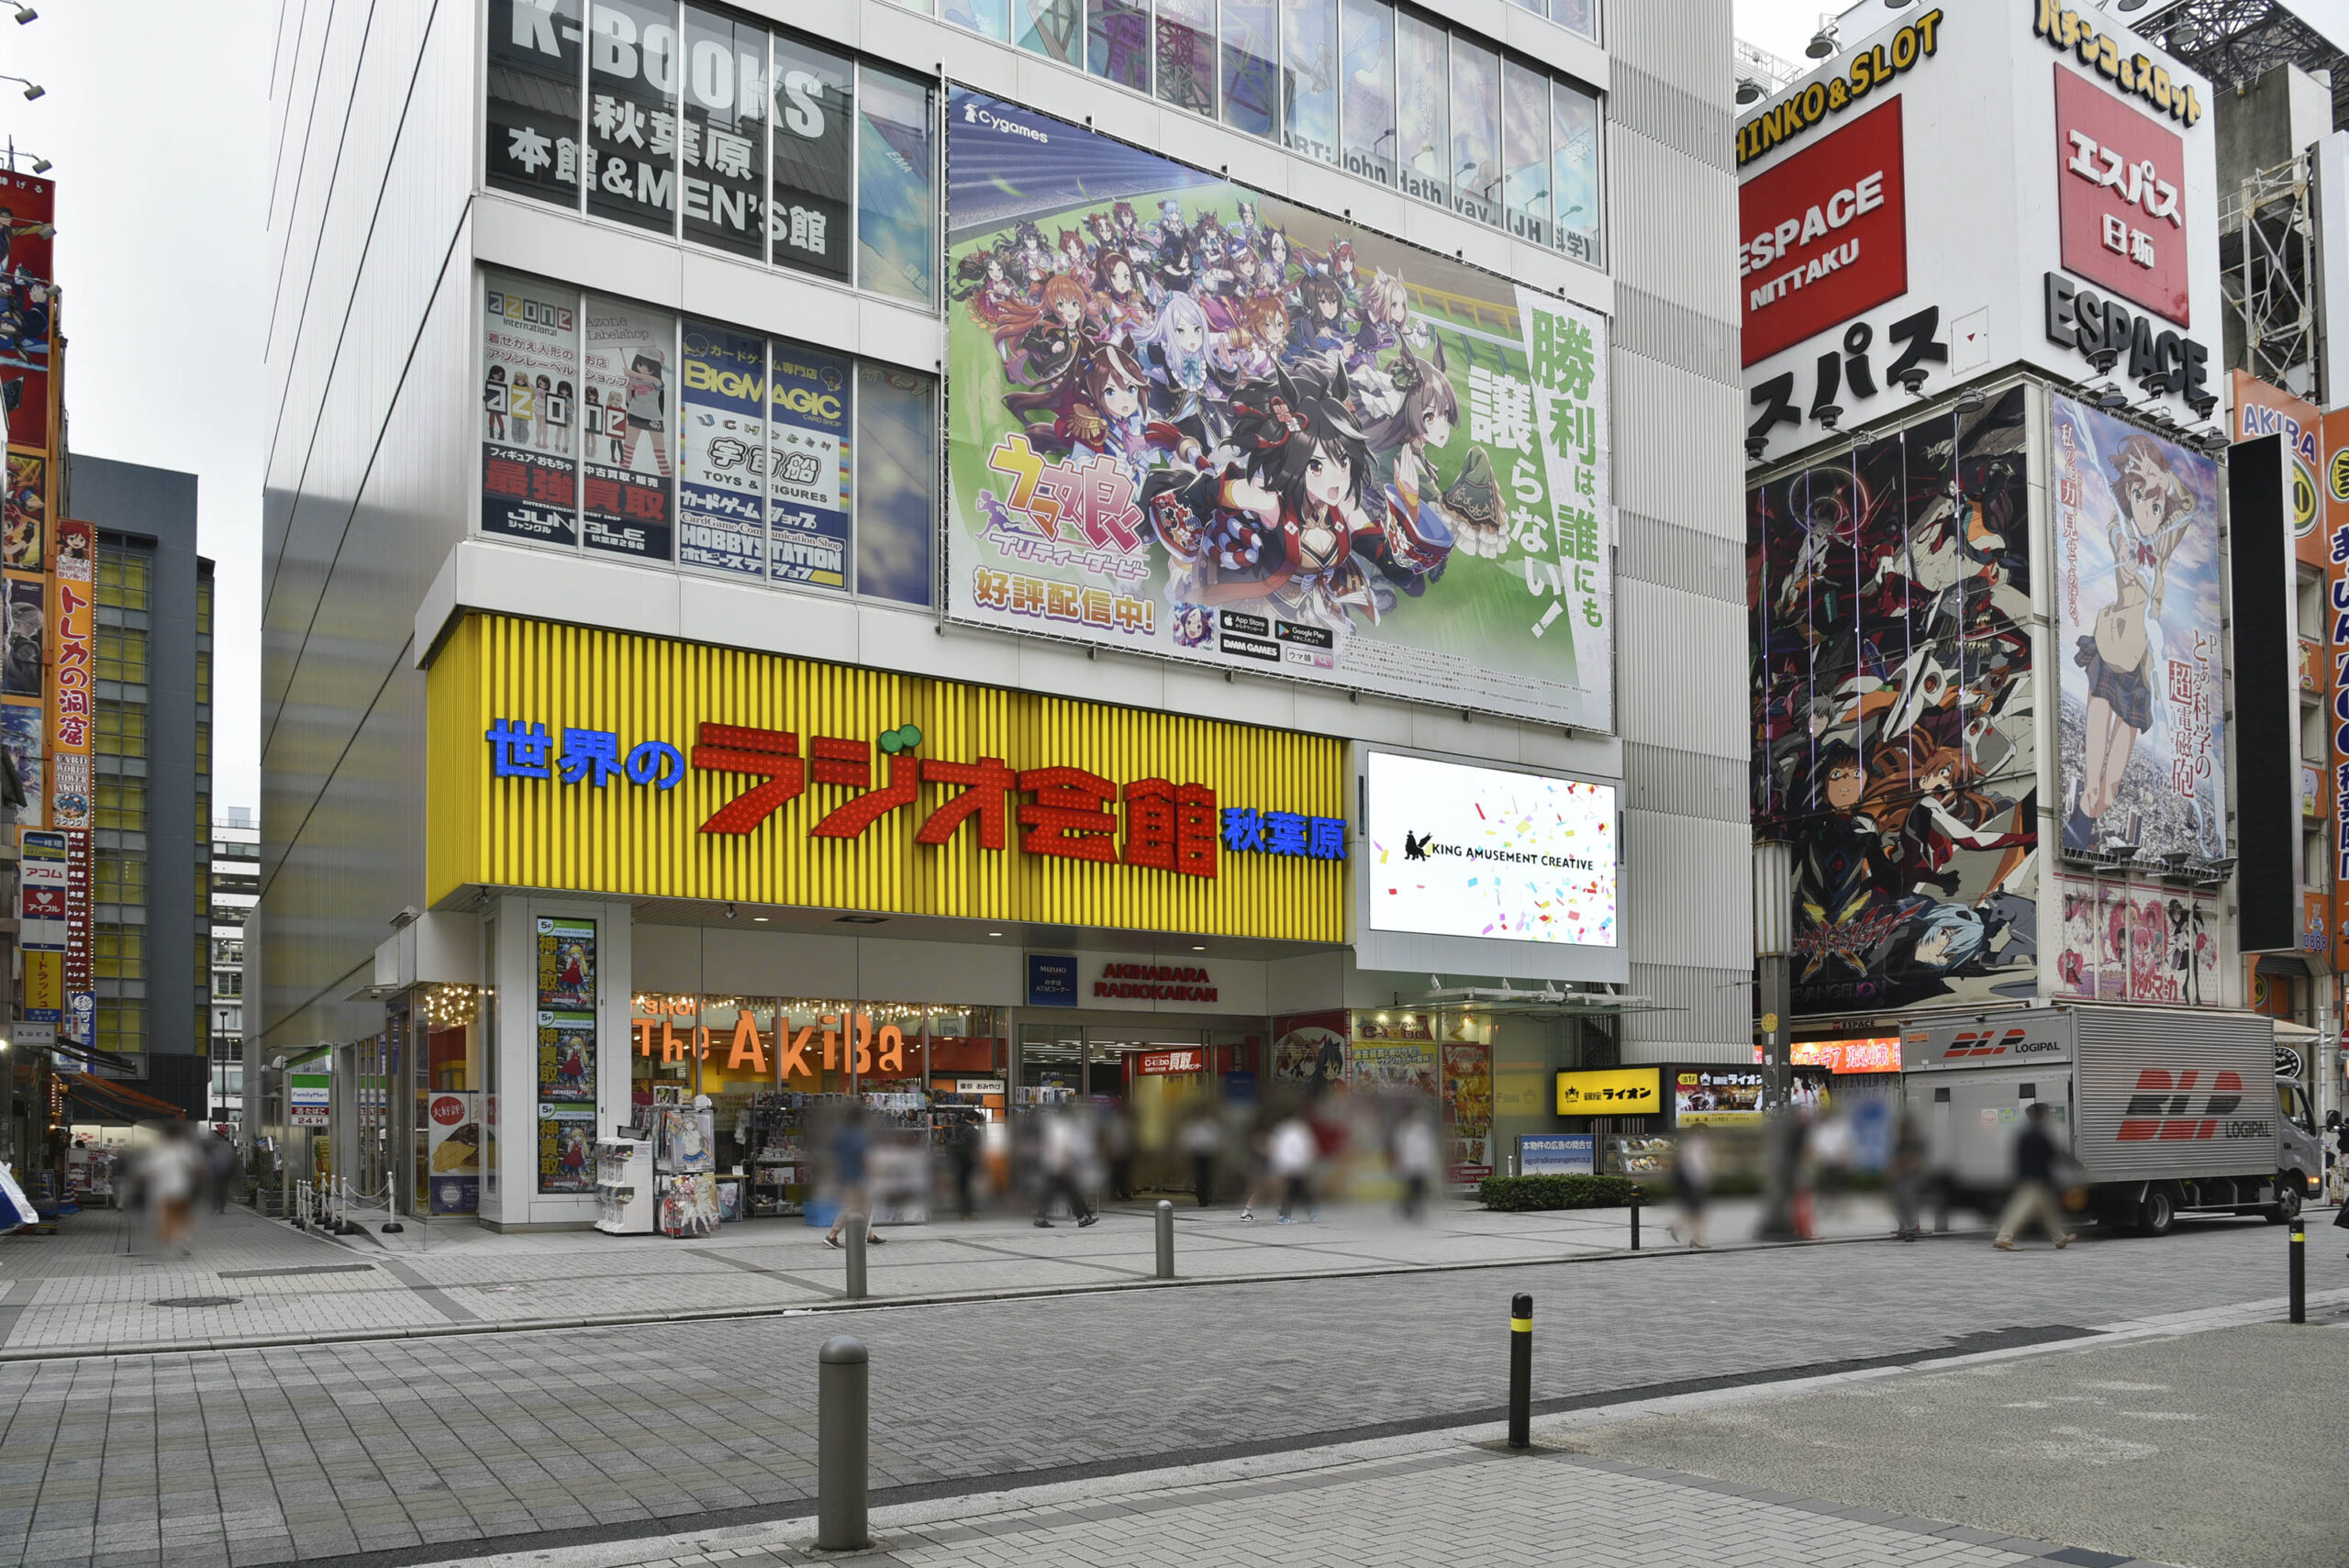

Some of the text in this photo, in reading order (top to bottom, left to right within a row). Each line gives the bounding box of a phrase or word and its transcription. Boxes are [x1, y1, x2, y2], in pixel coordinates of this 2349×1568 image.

[512, 0, 825, 139] K-BOOKS
[1829, 76, 1848, 113] &
[1849, 7, 1943, 97] SLOT
[593, 94, 753, 182] 秋葉原
[978, 109, 1048, 143] Cygames
[2067, 129, 2181, 228] エスパス
[1740, 171, 1885, 278] ESPACE
[2102, 213, 2154, 270] 日拓
[1750, 238, 1860, 312] NITTAKU
[488, 290, 573, 332] azone
[2044, 272, 2209, 402] ESPACE
[684, 358, 842, 420] BIGMAGIC
[1748, 306, 1948, 439] スパス
[802, 414, 842, 428] CARD SHOP
[2242, 403, 2317, 466] AKIBA
[484, 459, 665, 521] 最強買取
[703, 470, 742, 486] TOYS
[748, 479, 759, 490] &
[1531, 306, 1603, 628] 勝利は、誰にも
[818, 536, 842, 552] Shop
[988, 533, 1150, 580] プリティーダービー
[974, 565, 1156, 634] 好評配信中!
[1235, 616, 1265, 628] App Store
[1223, 639, 1278, 657] DMM GAMES
[1292, 627, 1325, 640] Google Play
[1288, 651, 1312, 663] ウマ娘
[2168, 659, 2195, 799] 超電磁砲
[1219, 806, 1349, 861] 秋葉原
[26, 867, 62, 879] アコム
[1431, 843, 1594, 871] KING AMUSEMENT CREATIVE
[28, 903, 61, 913] アイフル
[1093, 982, 1219, 1003] RADIOKAIKAN
[1102, 963, 1210, 984] AKIHABARA
[631, 1018, 710, 1063] The
[2015, 1041, 2061, 1053] LOGIPAL
[2225, 1118, 2272, 1140] LOGIPAL
